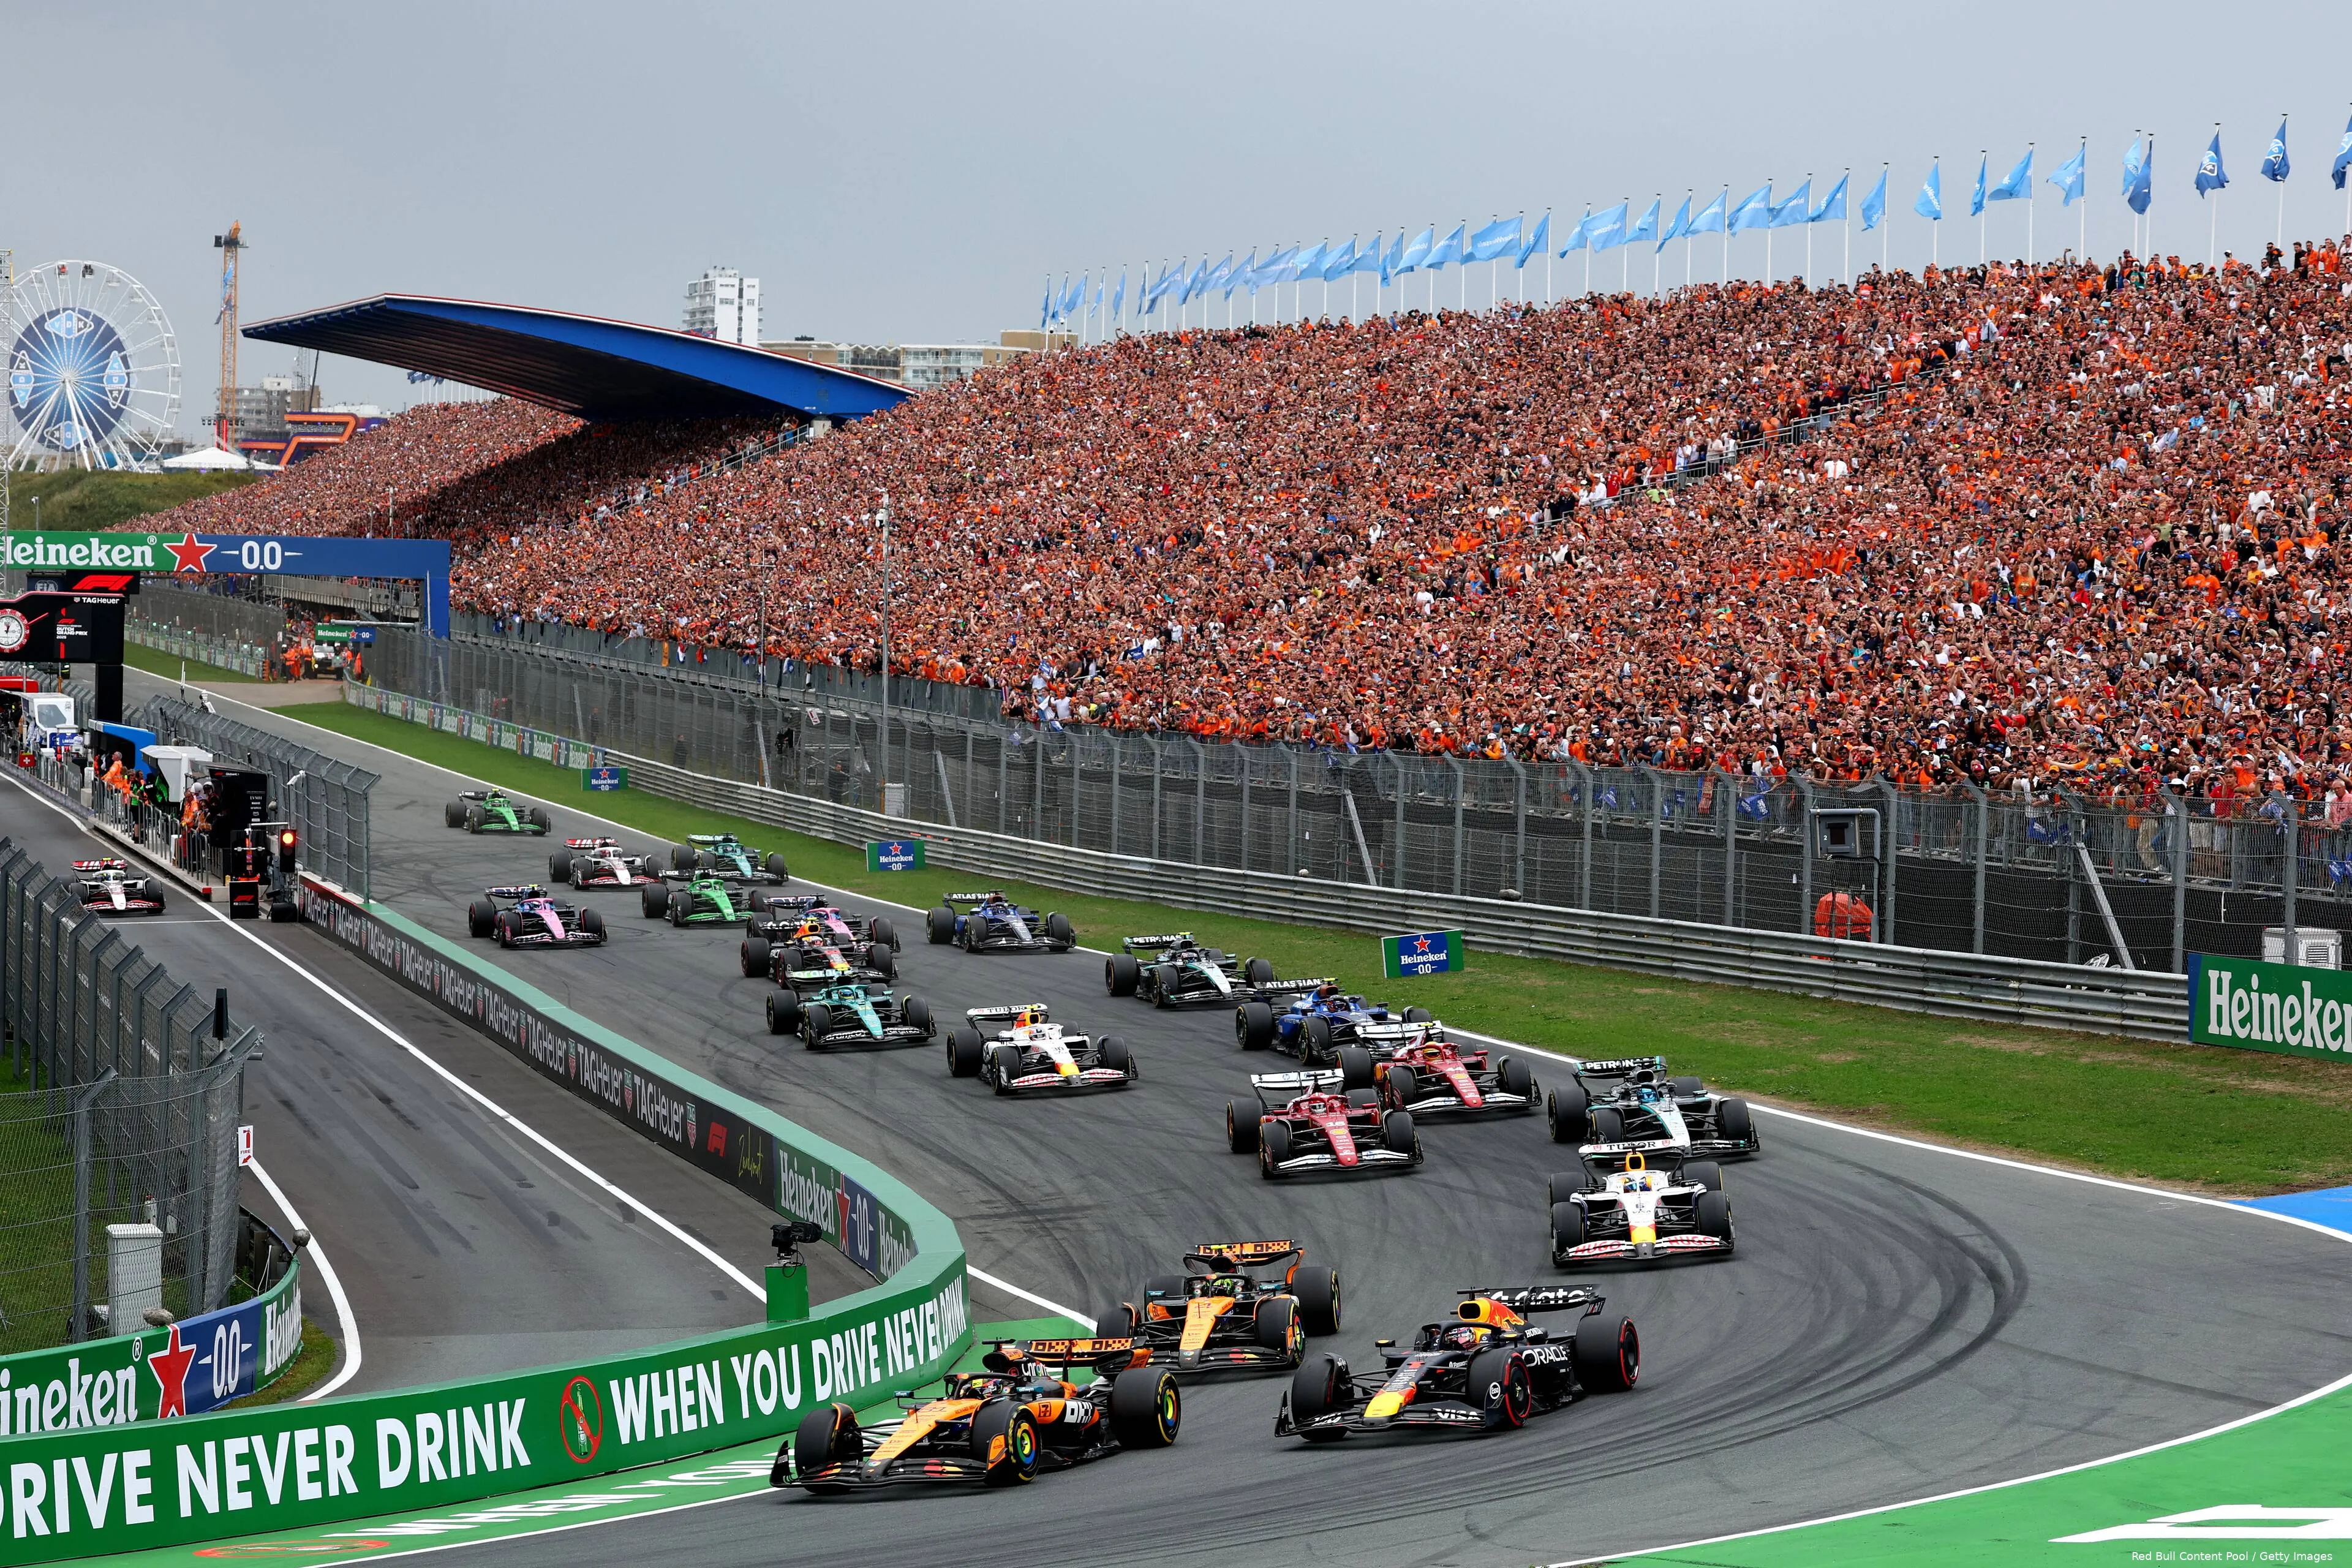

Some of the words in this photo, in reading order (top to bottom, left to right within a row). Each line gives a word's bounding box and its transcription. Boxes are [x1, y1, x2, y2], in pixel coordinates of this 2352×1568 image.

[318, 629, 347, 638] Heineken
[1401, 952, 1446, 965] Heineken
[1266, 978, 1321, 989] ATLASSIAN
[779, 1149, 835, 1236] Heineken
[1668, 1235, 1715, 1246] HUGO
[1574, 1241, 1621, 1254] HUGO
[212, 1319, 239, 1399] 0.0
[609, 1360, 725, 1445] WHEN
[730, 1344, 802, 1419] YOU
[812, 1321, 881, 1402] DRIVE
[884, 1298, 943, 1378] NEVER
[940, 1274, 967, 1351] DRINK
[1522, 1346, 1568, 1367] ORACLE
[1432, 1408, 1481, 1420] VISA
[0, 1449, 154, 1538] RIVE
[176, 1424, 359, 1518] NEVER
[376, 1398, 531, 1489] DRINK
